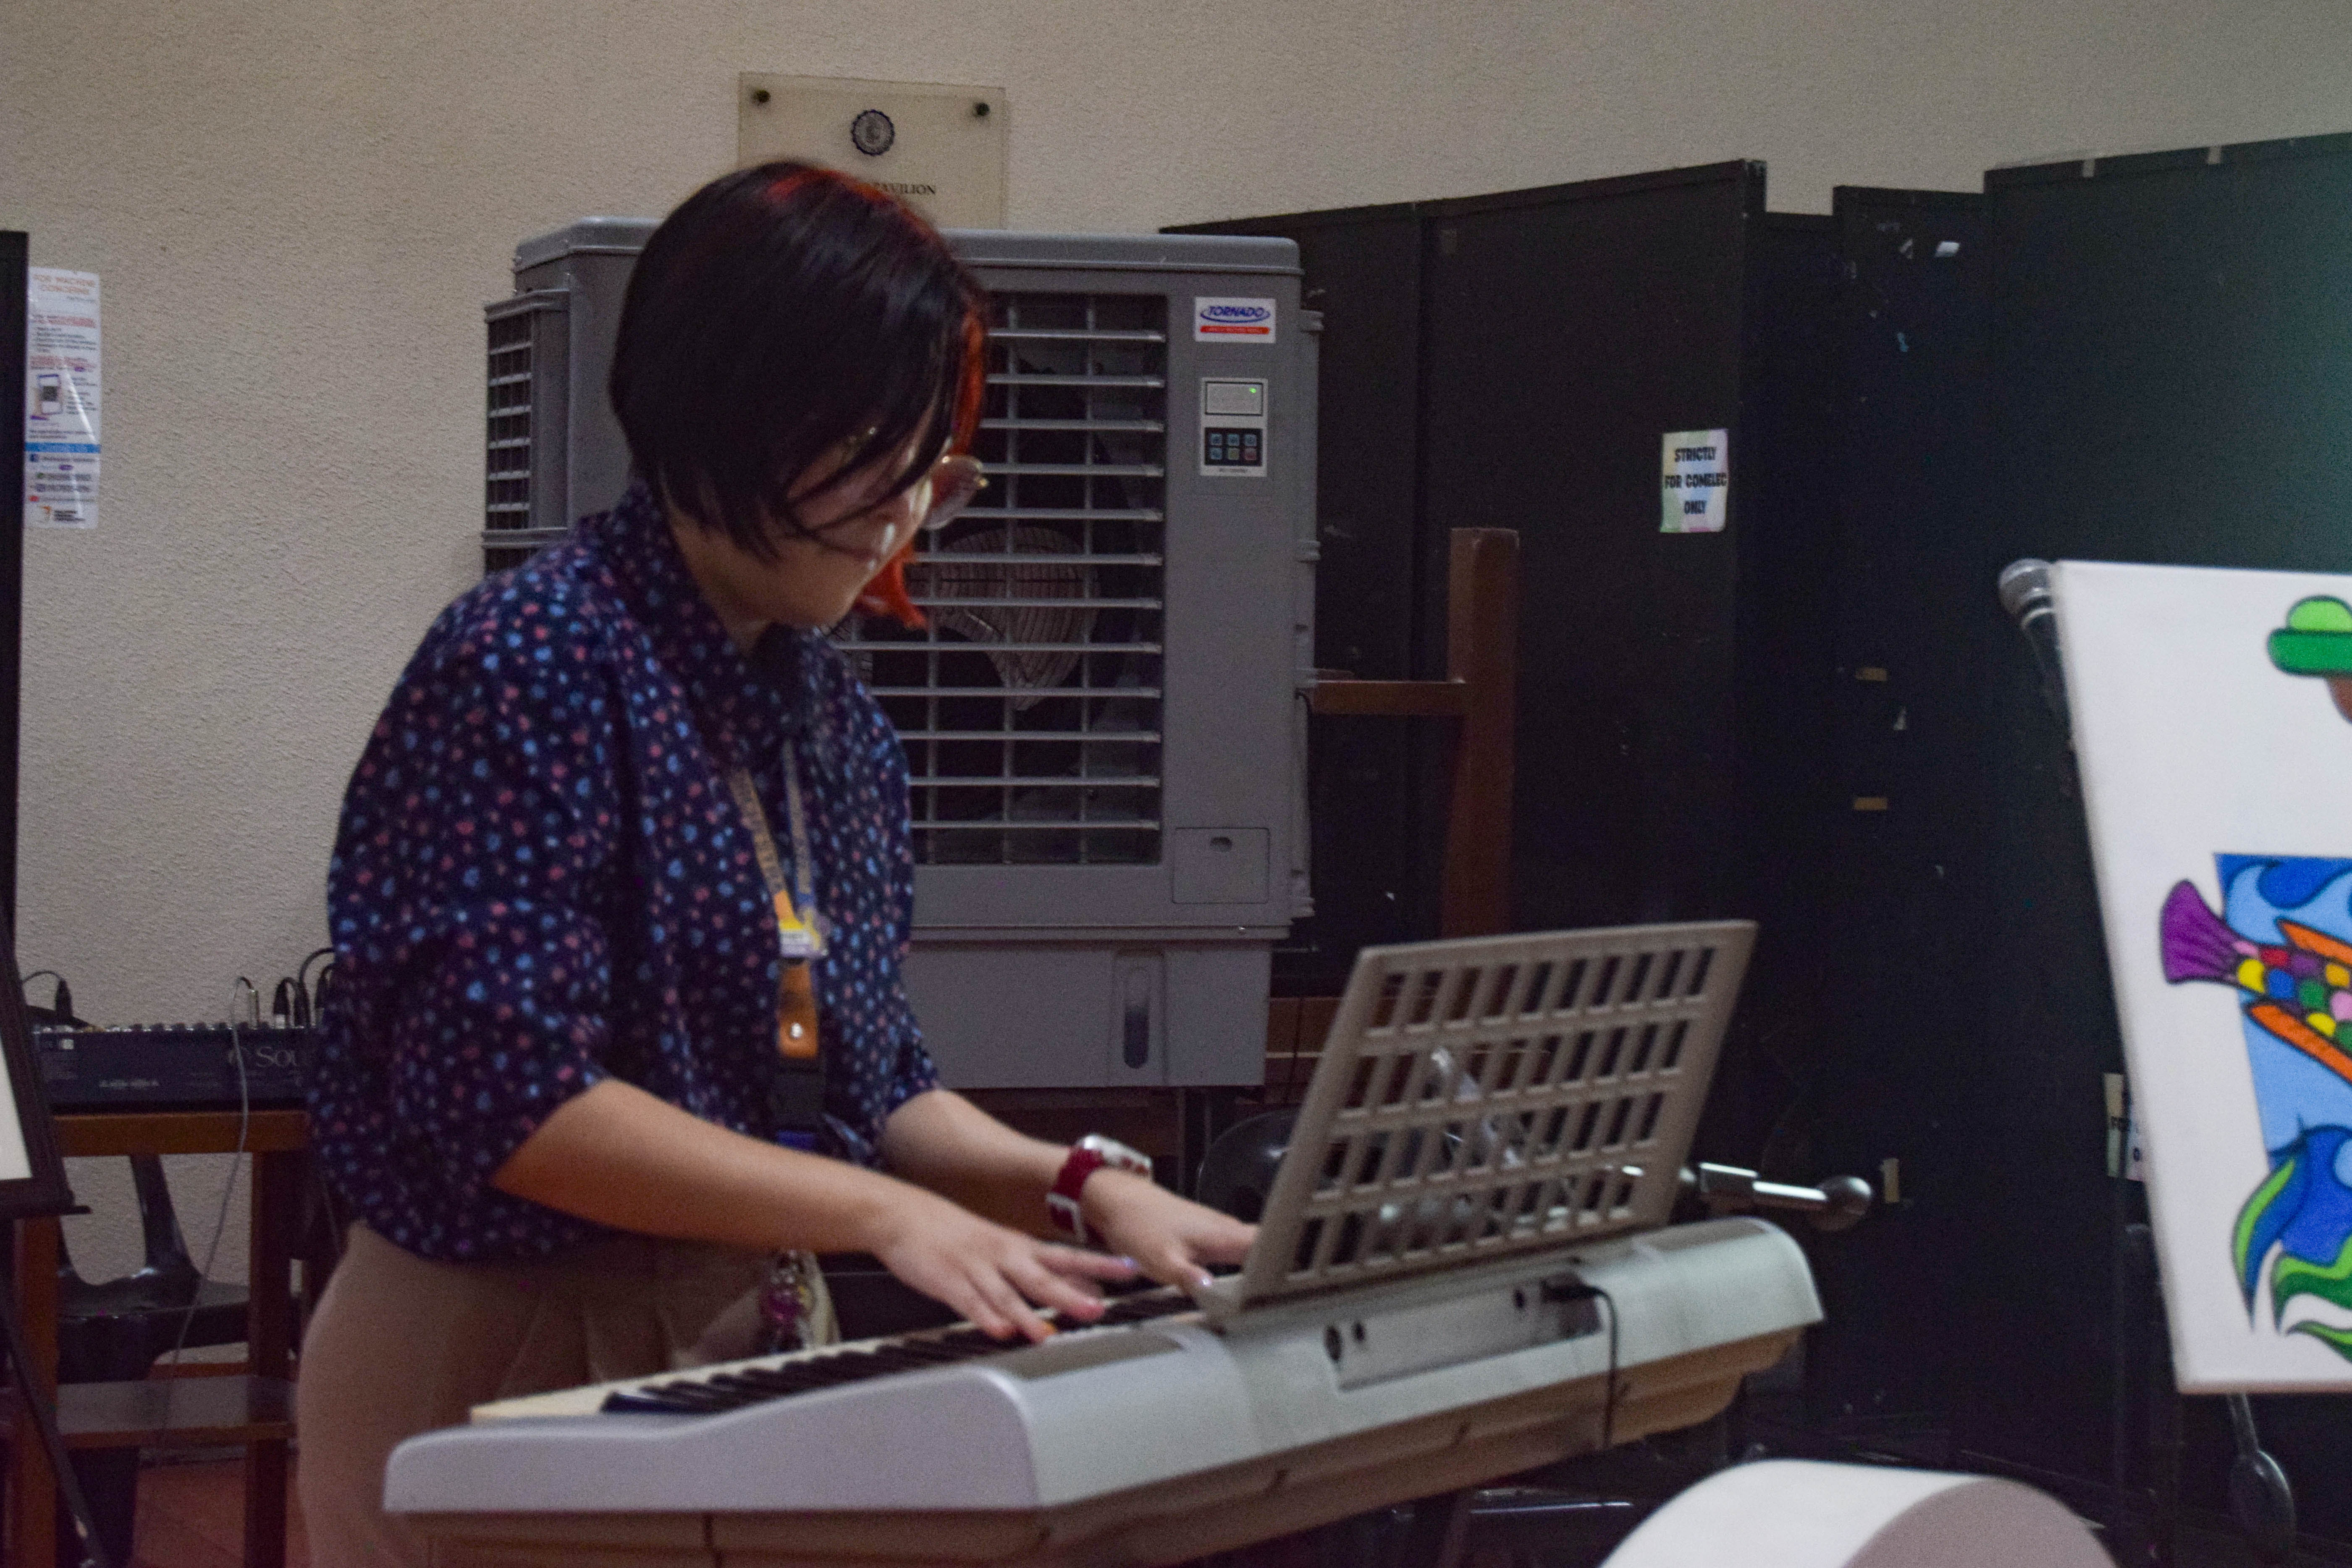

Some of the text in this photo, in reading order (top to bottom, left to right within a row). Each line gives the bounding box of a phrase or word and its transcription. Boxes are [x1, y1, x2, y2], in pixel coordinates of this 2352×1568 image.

[1209, 306, 1265, 318] TORNADO
[1675, 447, 1717, 462] STRICTLY
[1665, 472, 1728, 489] FOR COMELEC
[1684, 500, 1707, 514] ONLY
